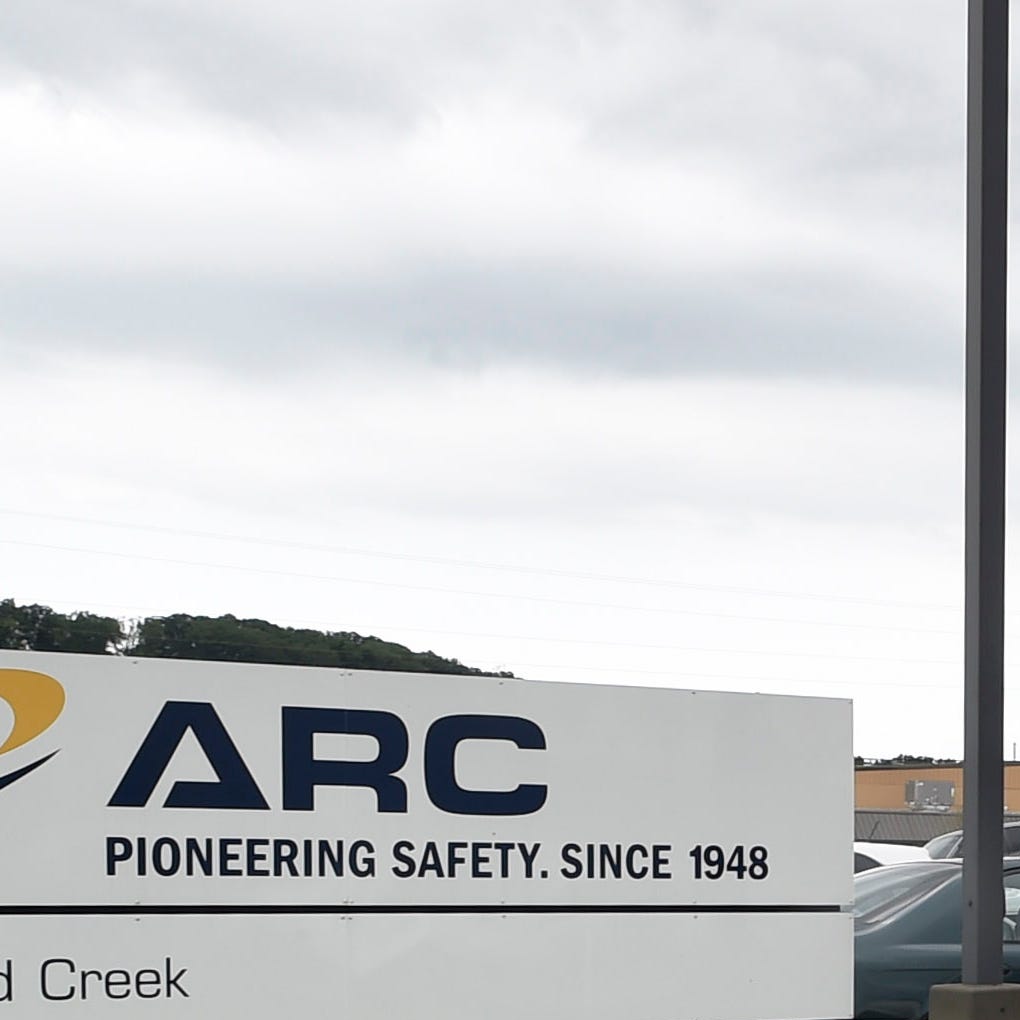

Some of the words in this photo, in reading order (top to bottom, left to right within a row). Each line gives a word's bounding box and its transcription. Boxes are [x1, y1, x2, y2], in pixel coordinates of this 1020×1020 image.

[107, 701, 548, 816] ARC
[106, 836, 376, 879] PIONEERING
[391, 840, 549, 880] SAFETY.
[560, 843, 673, 880] SINCE
[689, 844, 770, 881] 1948
[40, 957, 190, 1001] Creek
